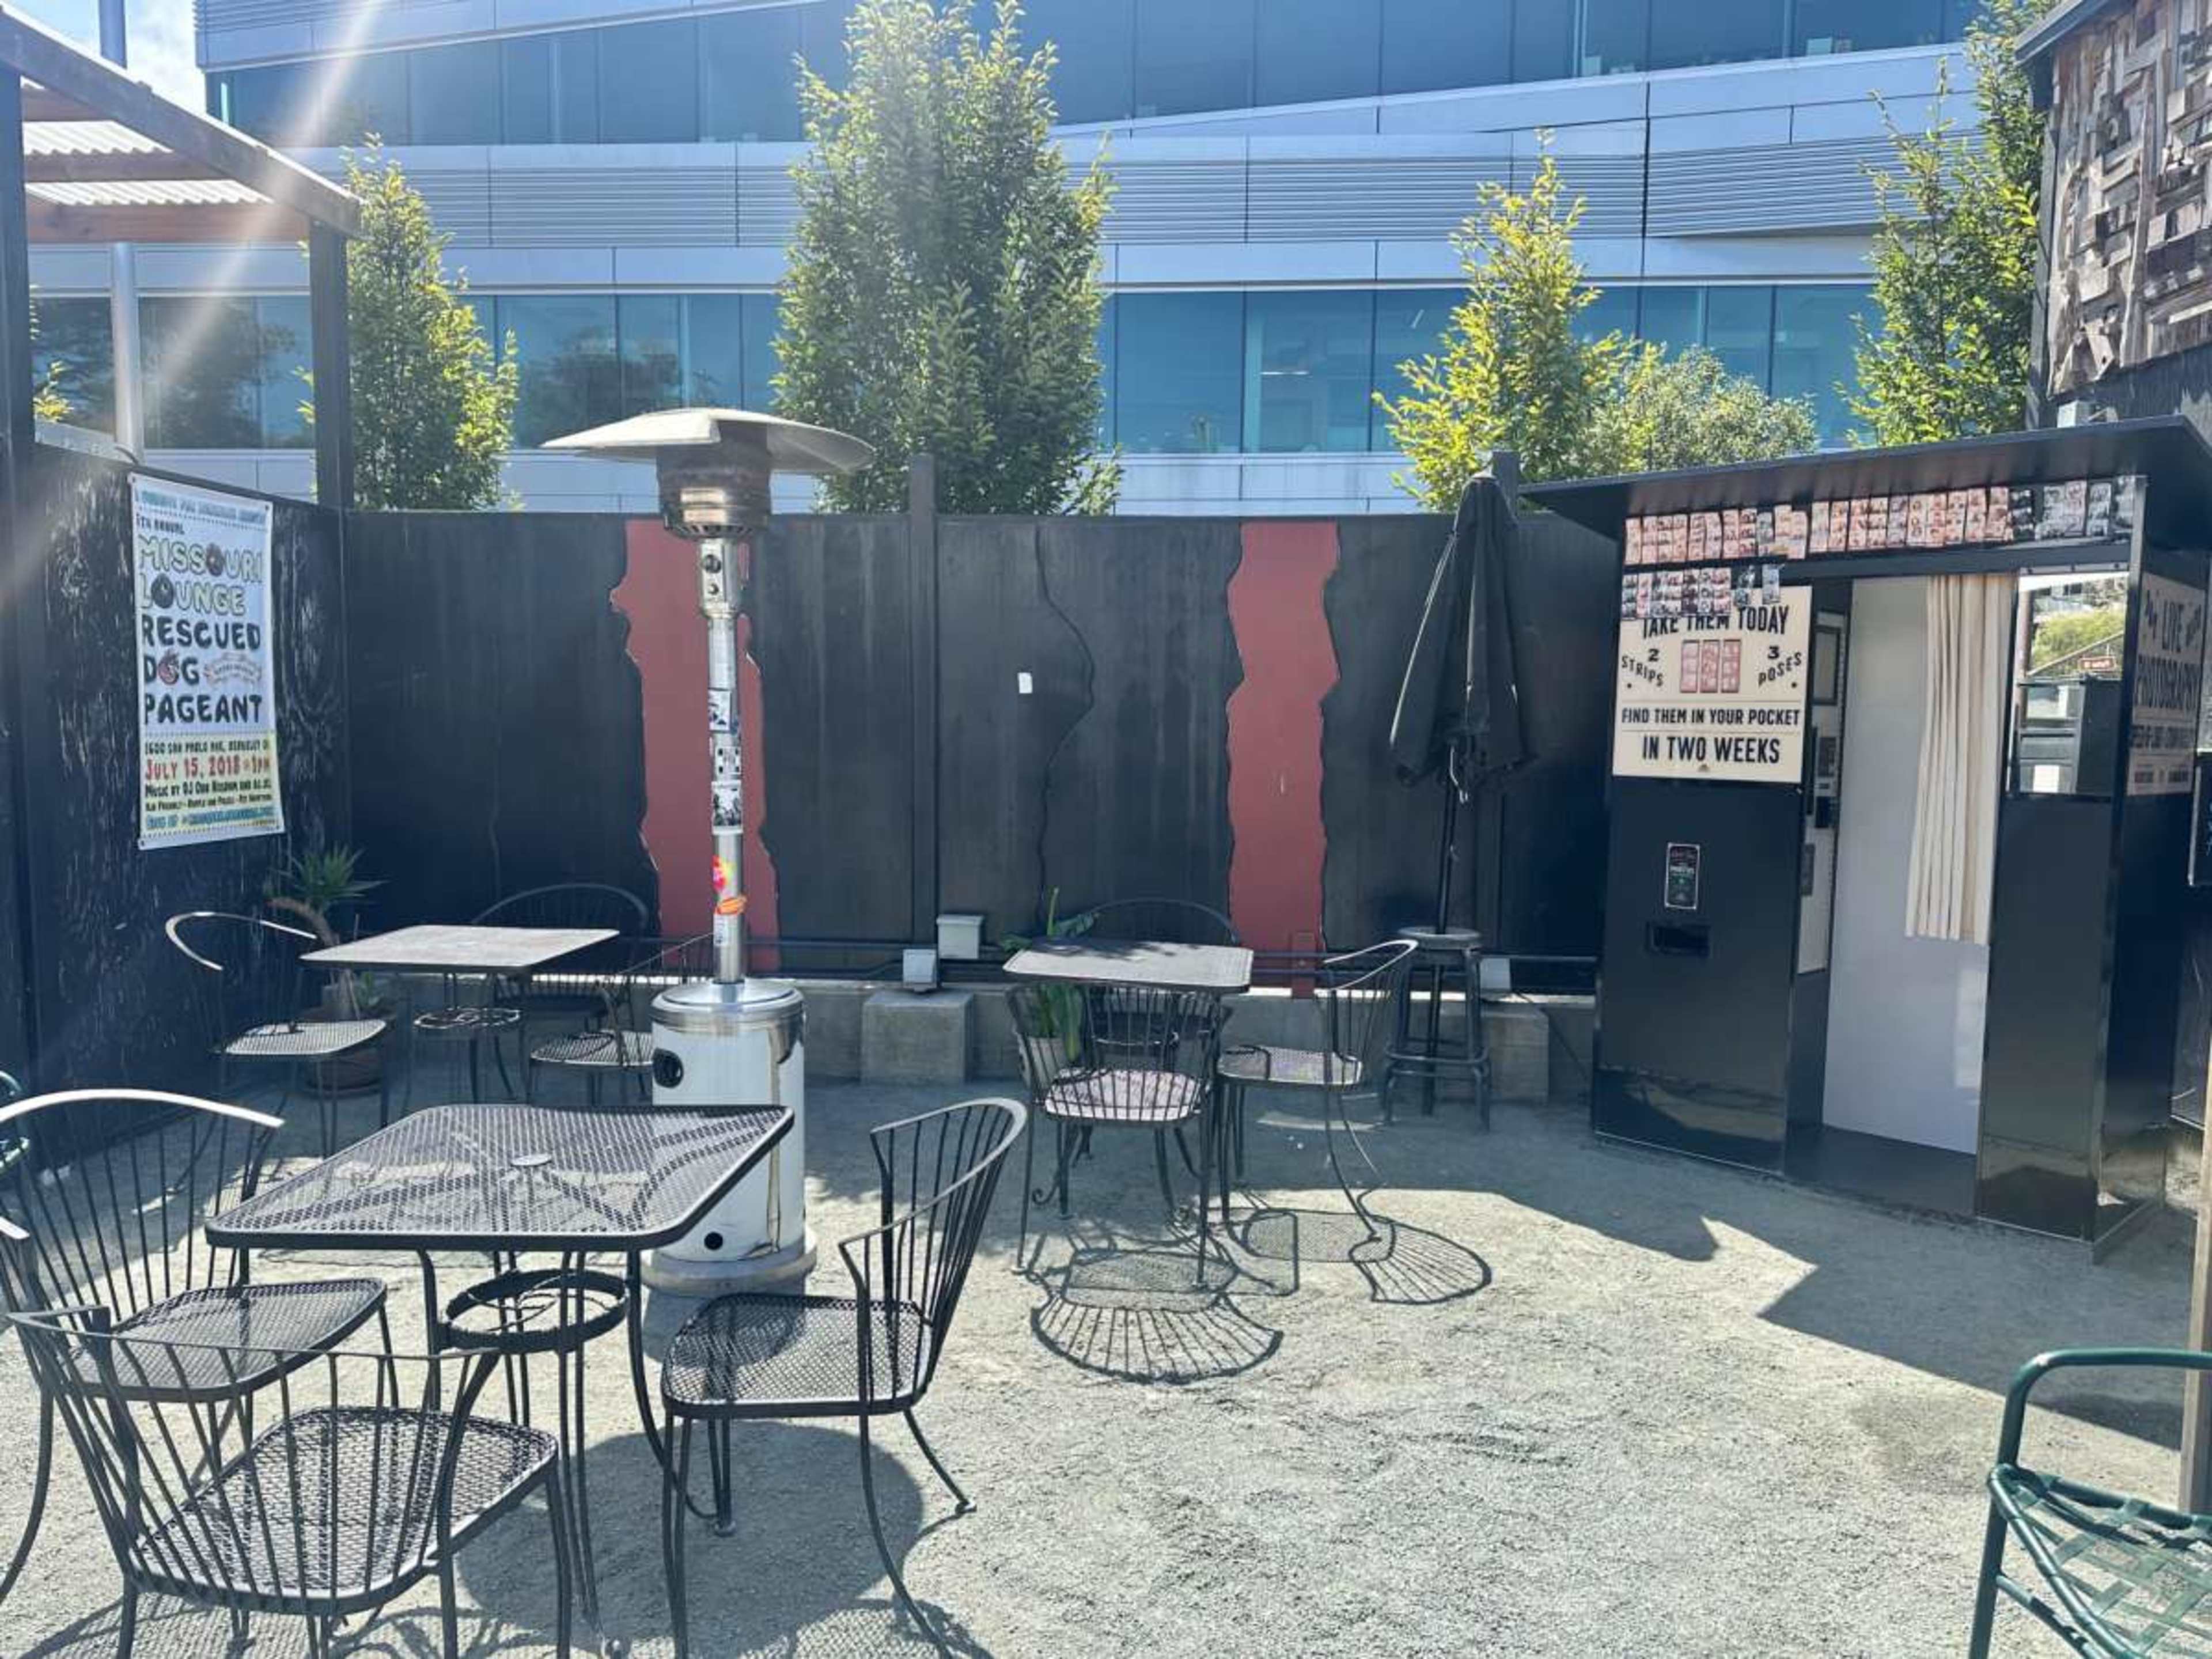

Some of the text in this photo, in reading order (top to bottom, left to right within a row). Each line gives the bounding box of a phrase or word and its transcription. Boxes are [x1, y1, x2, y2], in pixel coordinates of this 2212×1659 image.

[138, 533, 263, 583] MISSOURI
[138, 572, 246, 616] LOUNGE
[142, 614, 260, 650] RESCUED
[1737, 605, 1789, 634] TODAY
[144, 652, 200, 685] DOG
[1647, 649, 1660, 662] 2
[1767, 646, 1780, 660] 3
[1622, 656, 1664, 687] STRIPS
[1758, 652, 1802, 686] POSES
[145, 693, 262, 725] PAGEANT
[1622, 708, 1800, 725] FIND THEM IN YOUR POCKET
[209, 754, 240, 776] 2018
[1642, 736, 1780, 764] IN TWO WEEKS
